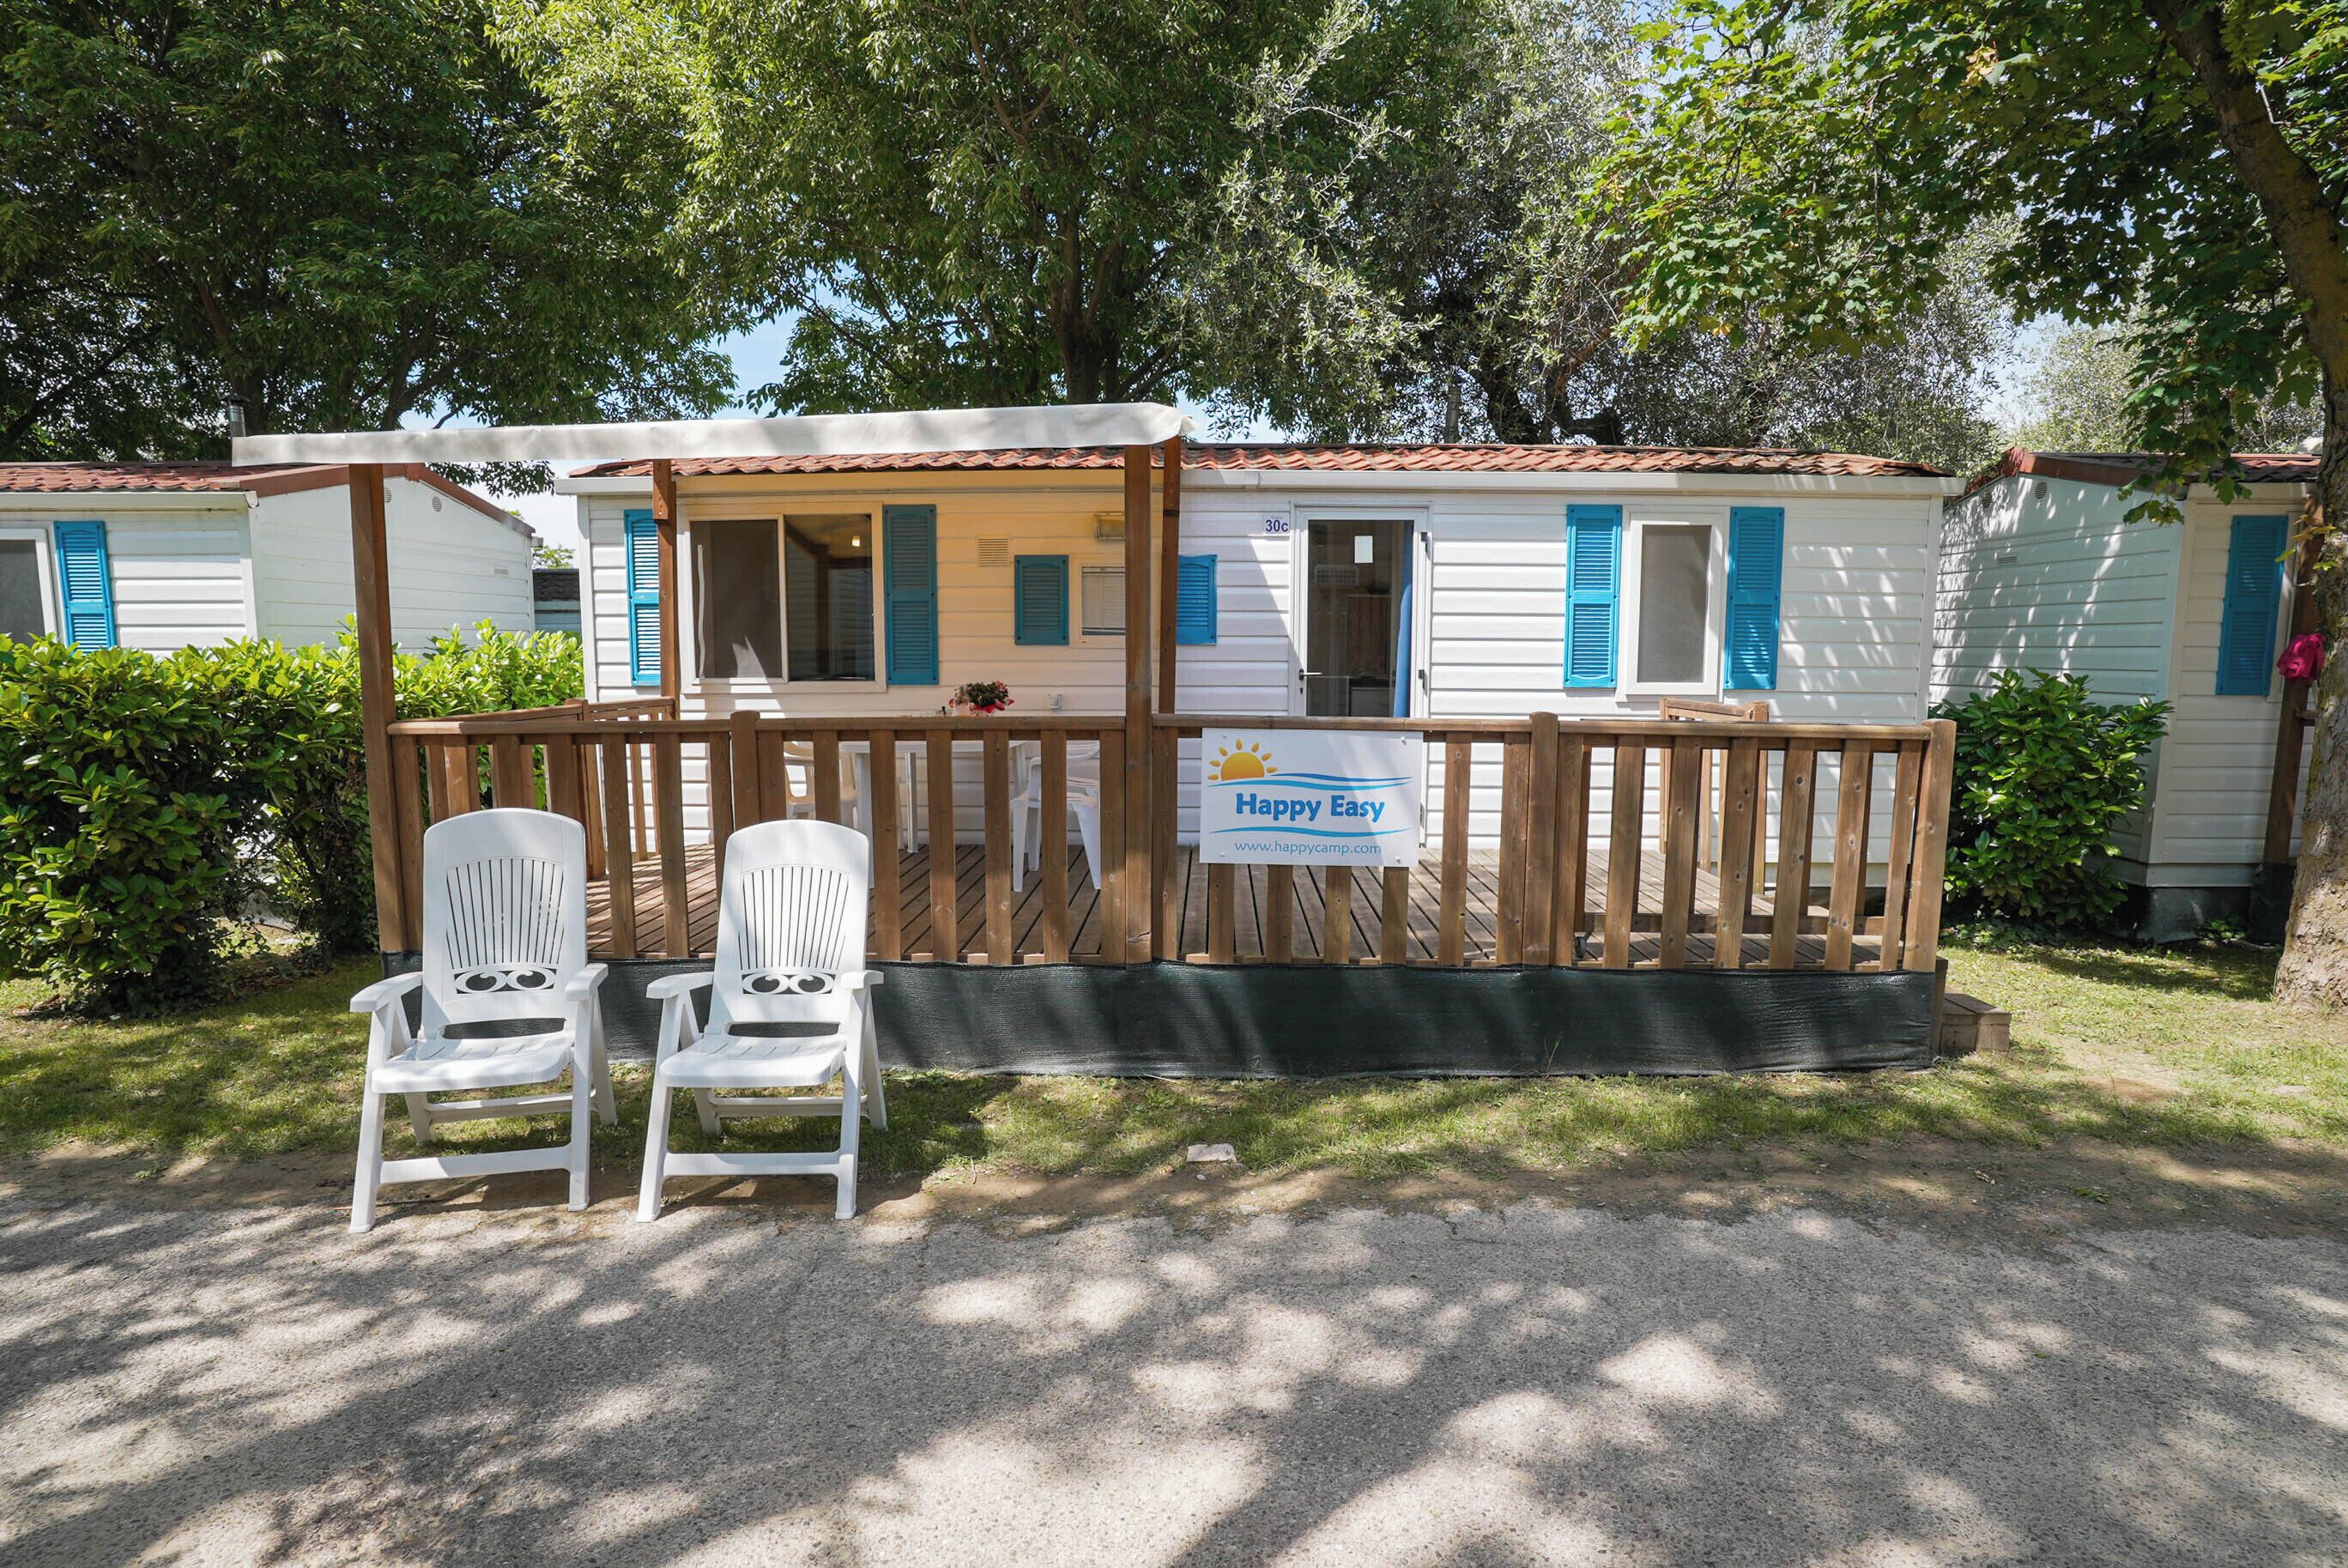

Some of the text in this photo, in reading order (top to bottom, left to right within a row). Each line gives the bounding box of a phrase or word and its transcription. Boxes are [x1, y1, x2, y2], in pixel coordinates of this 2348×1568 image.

[1265, 519, 1289, 532] 30c
[1236, 792, 1385, 822] Happy Easy
[1235, 841, 1382, 856] www.happycamp.com
